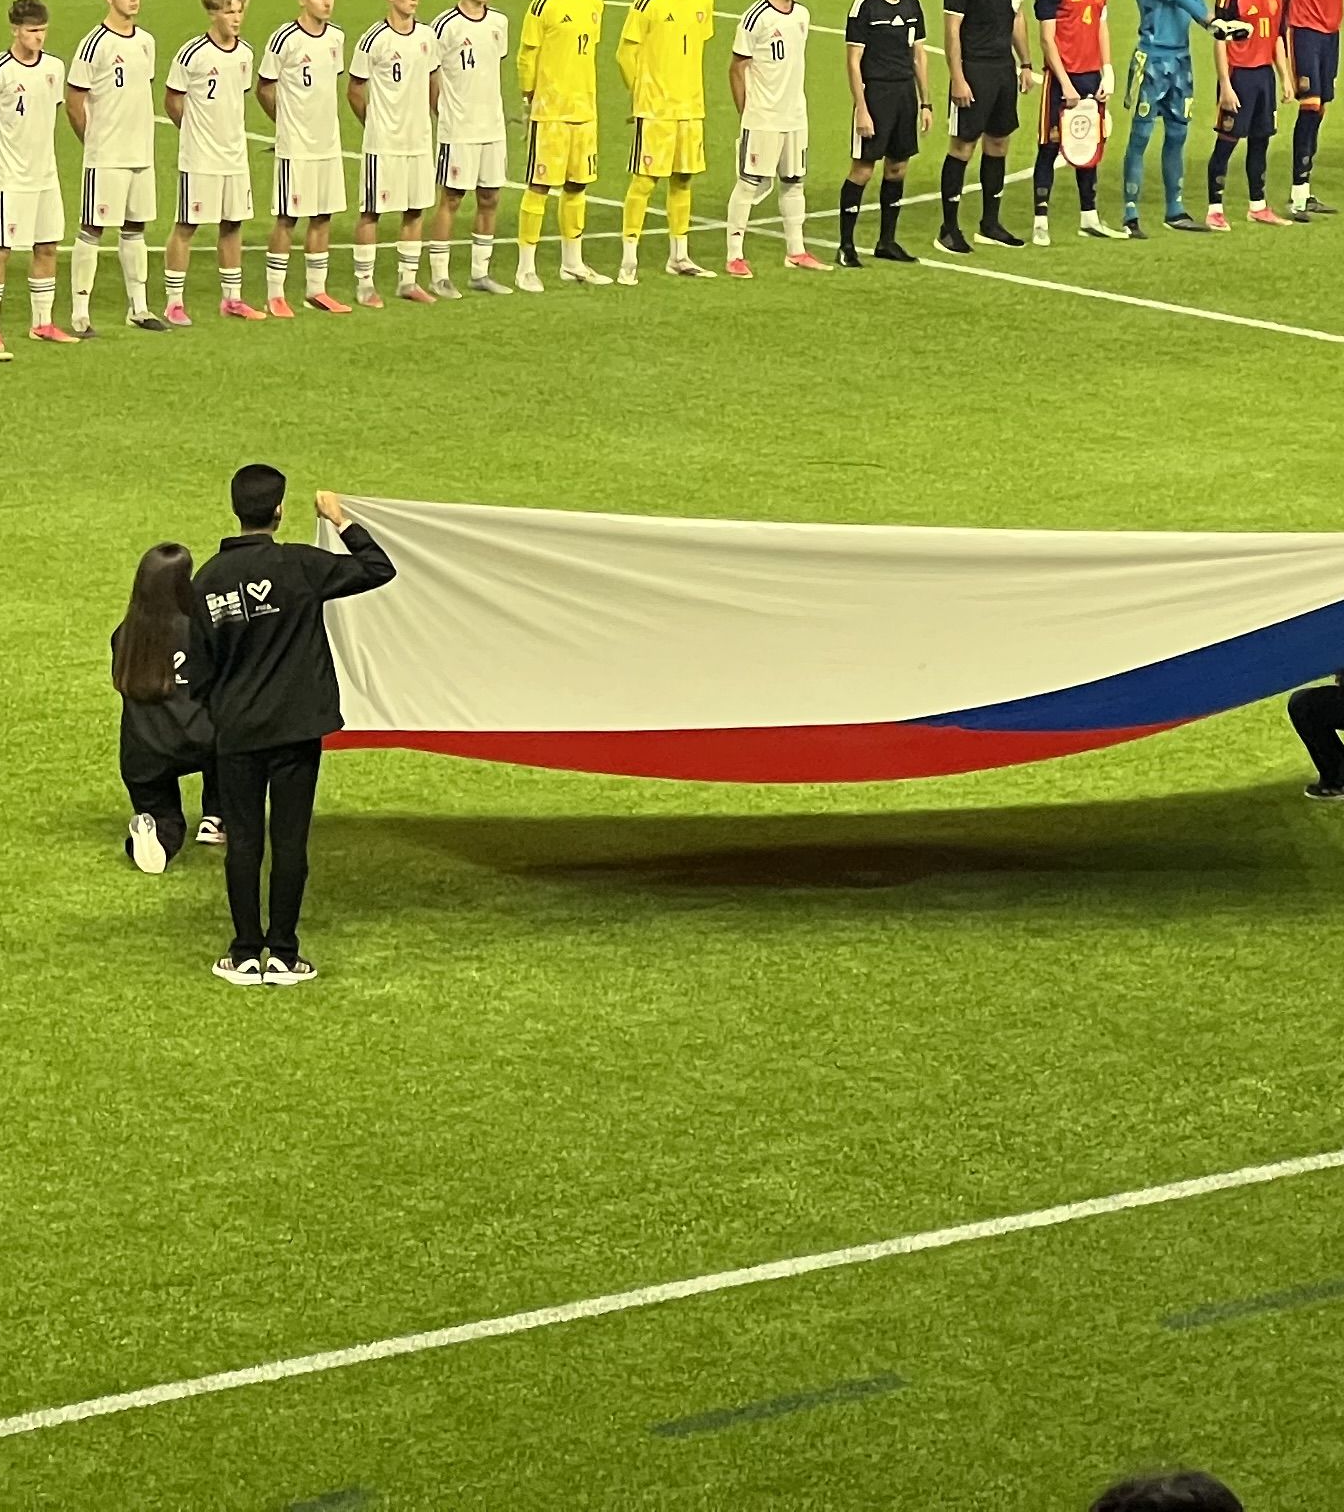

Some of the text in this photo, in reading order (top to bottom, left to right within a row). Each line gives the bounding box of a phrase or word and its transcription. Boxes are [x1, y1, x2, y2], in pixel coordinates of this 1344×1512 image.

[1082, 5, 1093, 25] 4
[1258, 17, 1271, 38] 11
[577, 33, 589, 56] 12
[770, 39, 785, 61] 10
[460, 48, 475, 70] 14
[114, 67, 124, 88] 3
[302, 65, 312, 87] 5
[207, 79, 217, 99] 2
[15, 95, 25, 117] 4
